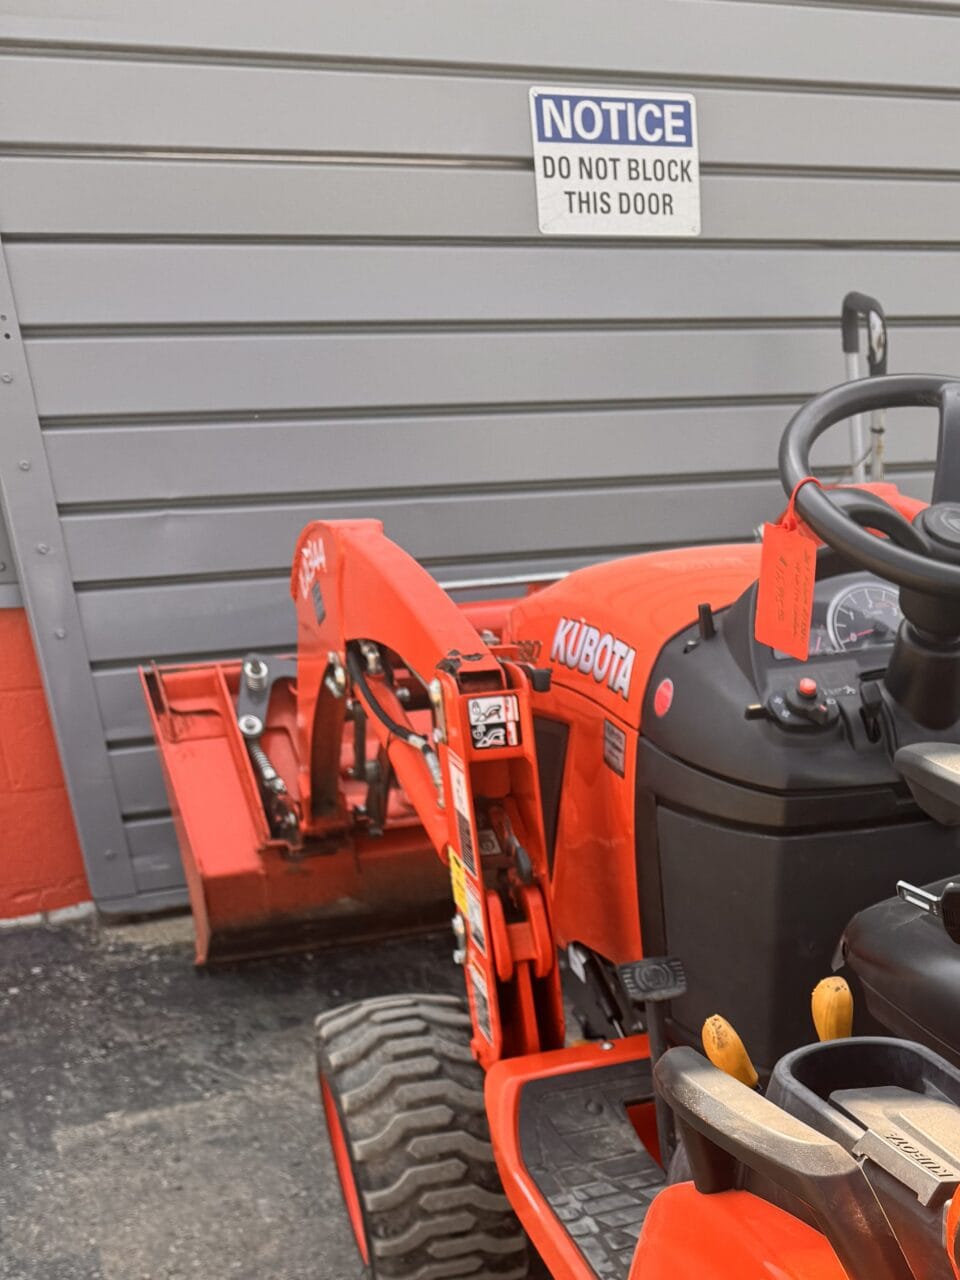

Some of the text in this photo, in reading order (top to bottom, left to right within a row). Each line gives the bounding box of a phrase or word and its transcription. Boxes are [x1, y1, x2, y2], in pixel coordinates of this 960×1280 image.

[541, 98, 686, 143] NOTICE
[543, 155, 692, 183] DO NOT BLOCK
[564, 191, 673, 216] THIS DOOR
[550, 616, 637, 702] KUBOTA
[884, 1131, 954, 1178] KUBOTA
